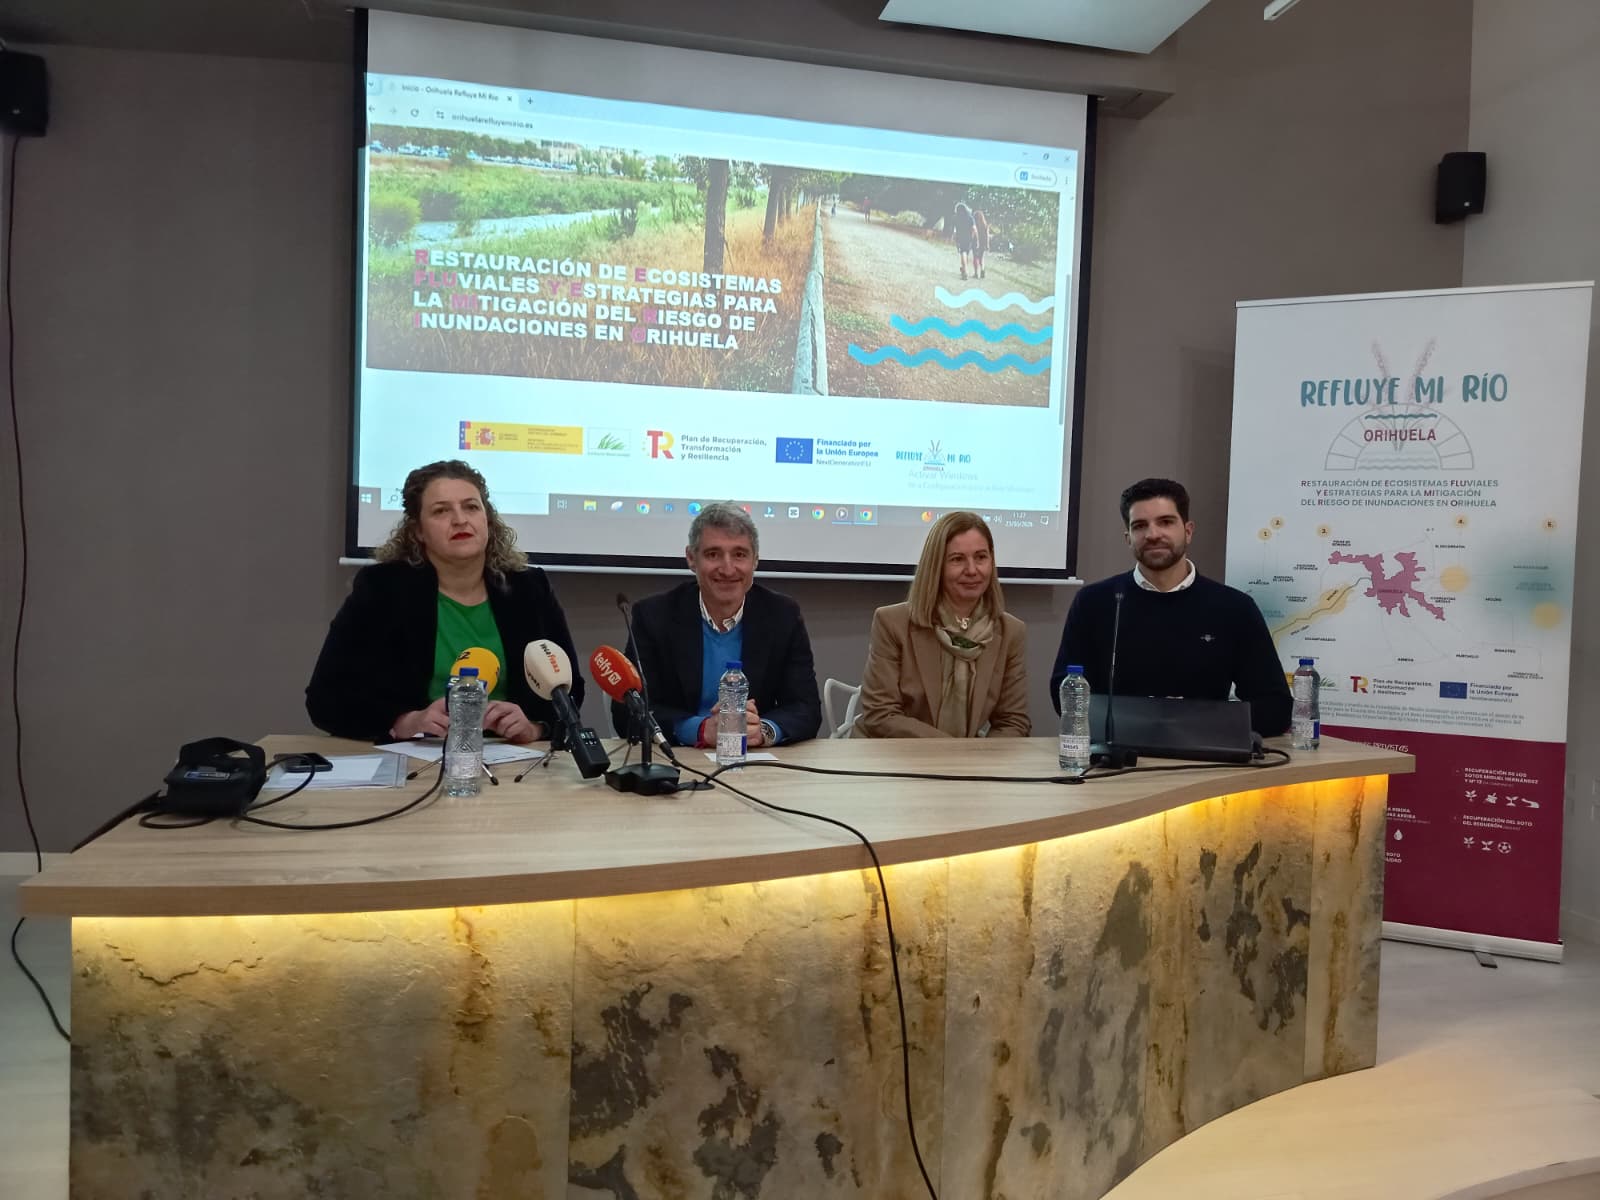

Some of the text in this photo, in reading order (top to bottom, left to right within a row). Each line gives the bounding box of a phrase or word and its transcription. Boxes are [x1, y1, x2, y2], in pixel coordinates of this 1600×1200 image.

[415, 250, 782, 294] RESTAURACIÓN DE ECOSISTEMAS
[414, 271, 778, 313] FLUVIALES Y ESTRATEGIAS PARA
[413, 292, 756, 332] LA MITIGACIÓN DEL RIESGO DE
[414, 313, 739, 350] INUNDACIONES EN ORIHUELA
[1301, 372, 1508, 407] REFLUYE MI RÍO
[681, 434, 698, 442] Plan
[712, 436, 767, 446] Recuperación,
[1363, 429, 1437, 442] ORIHUELA
[681, 444, 741, 453] Transformación
[817, 438, 871, 449] Financiado por
[688, 453, 729, 461] Resiliencia
[825, 448, 847, 456] Unión
[848, 449, 879, 458] Europea
[1301, 478, 1369, 487] RESTAURACIÓN
[1423, 488, 1481, 497] MITIGACIÓN
[1365, 499, 1434, 507] INUNDACIONES
[1436, 499, 1448, 507] EN
[1450, 499, 1496, 507] ORIHUELA
[594, 652, 613, 677] telfy
